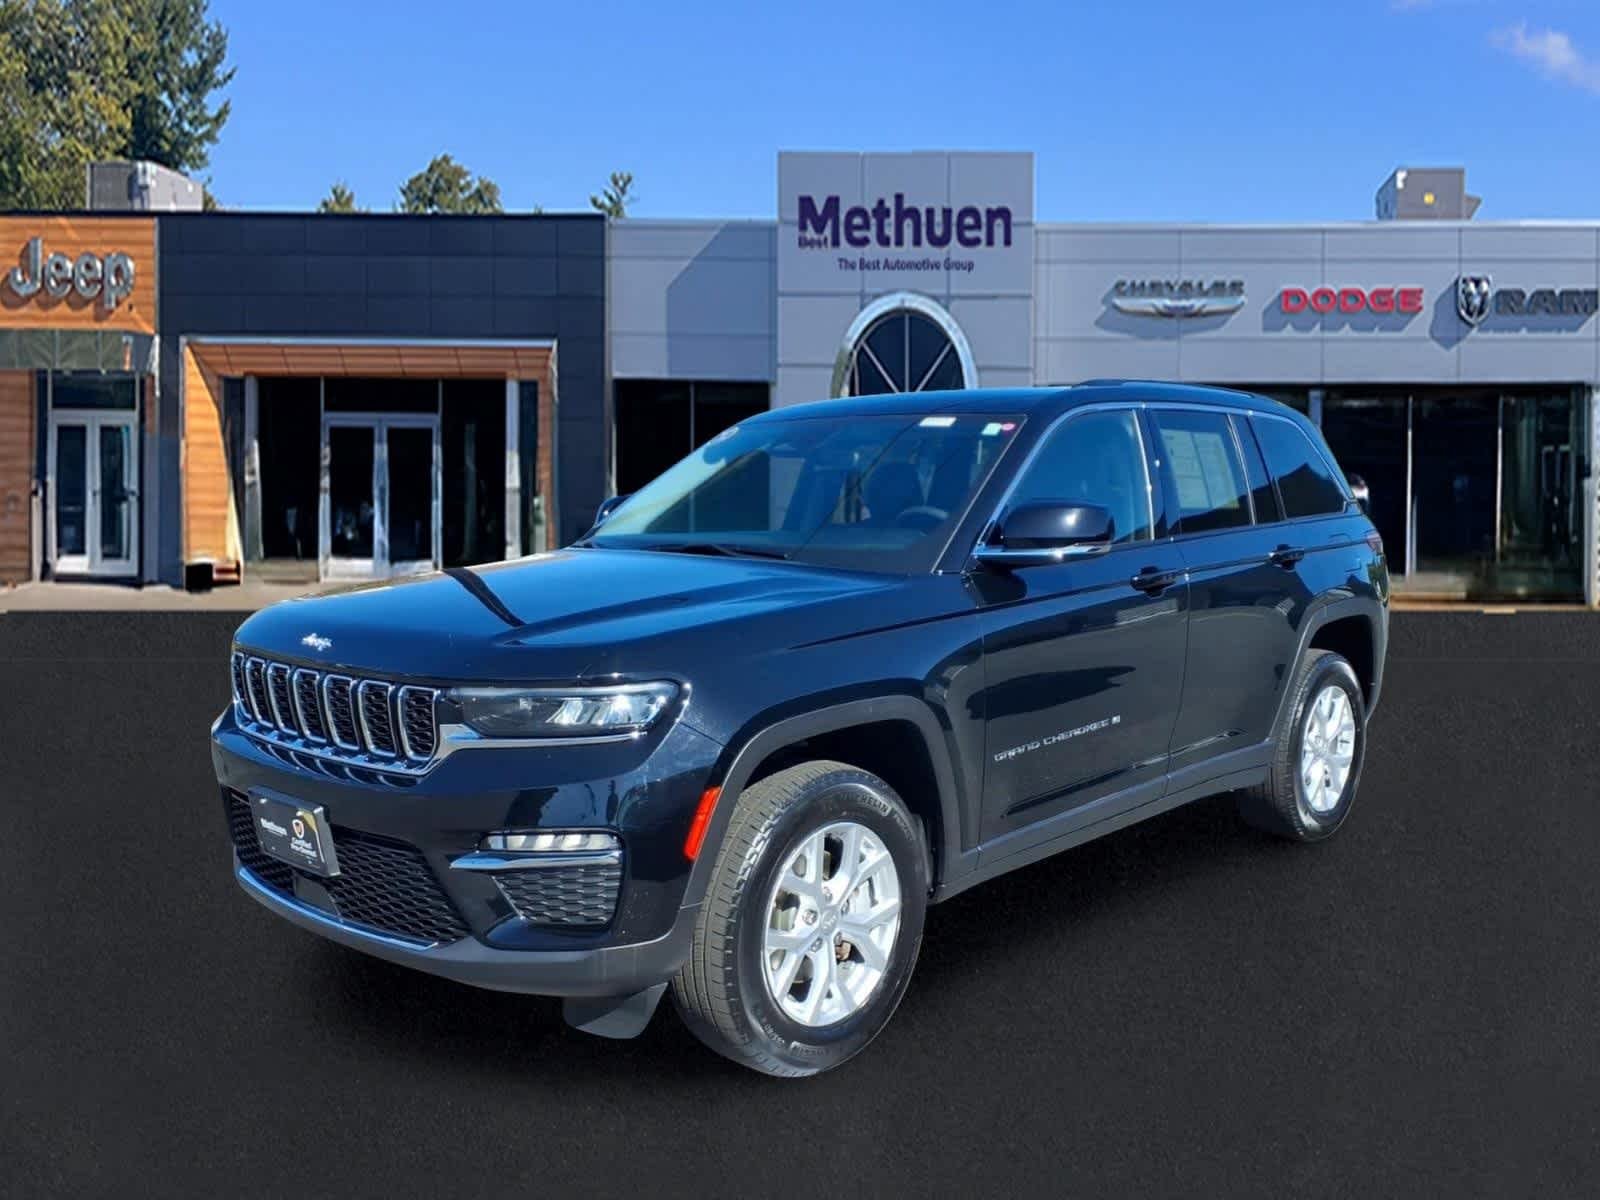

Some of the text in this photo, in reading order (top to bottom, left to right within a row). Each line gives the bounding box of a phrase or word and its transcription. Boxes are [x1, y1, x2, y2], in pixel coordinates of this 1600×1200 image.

[798, 192, 1012, 248] Methuen
[9, 236, 135, 309] Jeep
[838, 257, 975, 274] The Best Automotive Group
[1281, 287, 1423, 314] DODGE
[1495, 289, 1598, 315] RAM
[994, 718, 1110, 762] GRAND CHEROKEE
